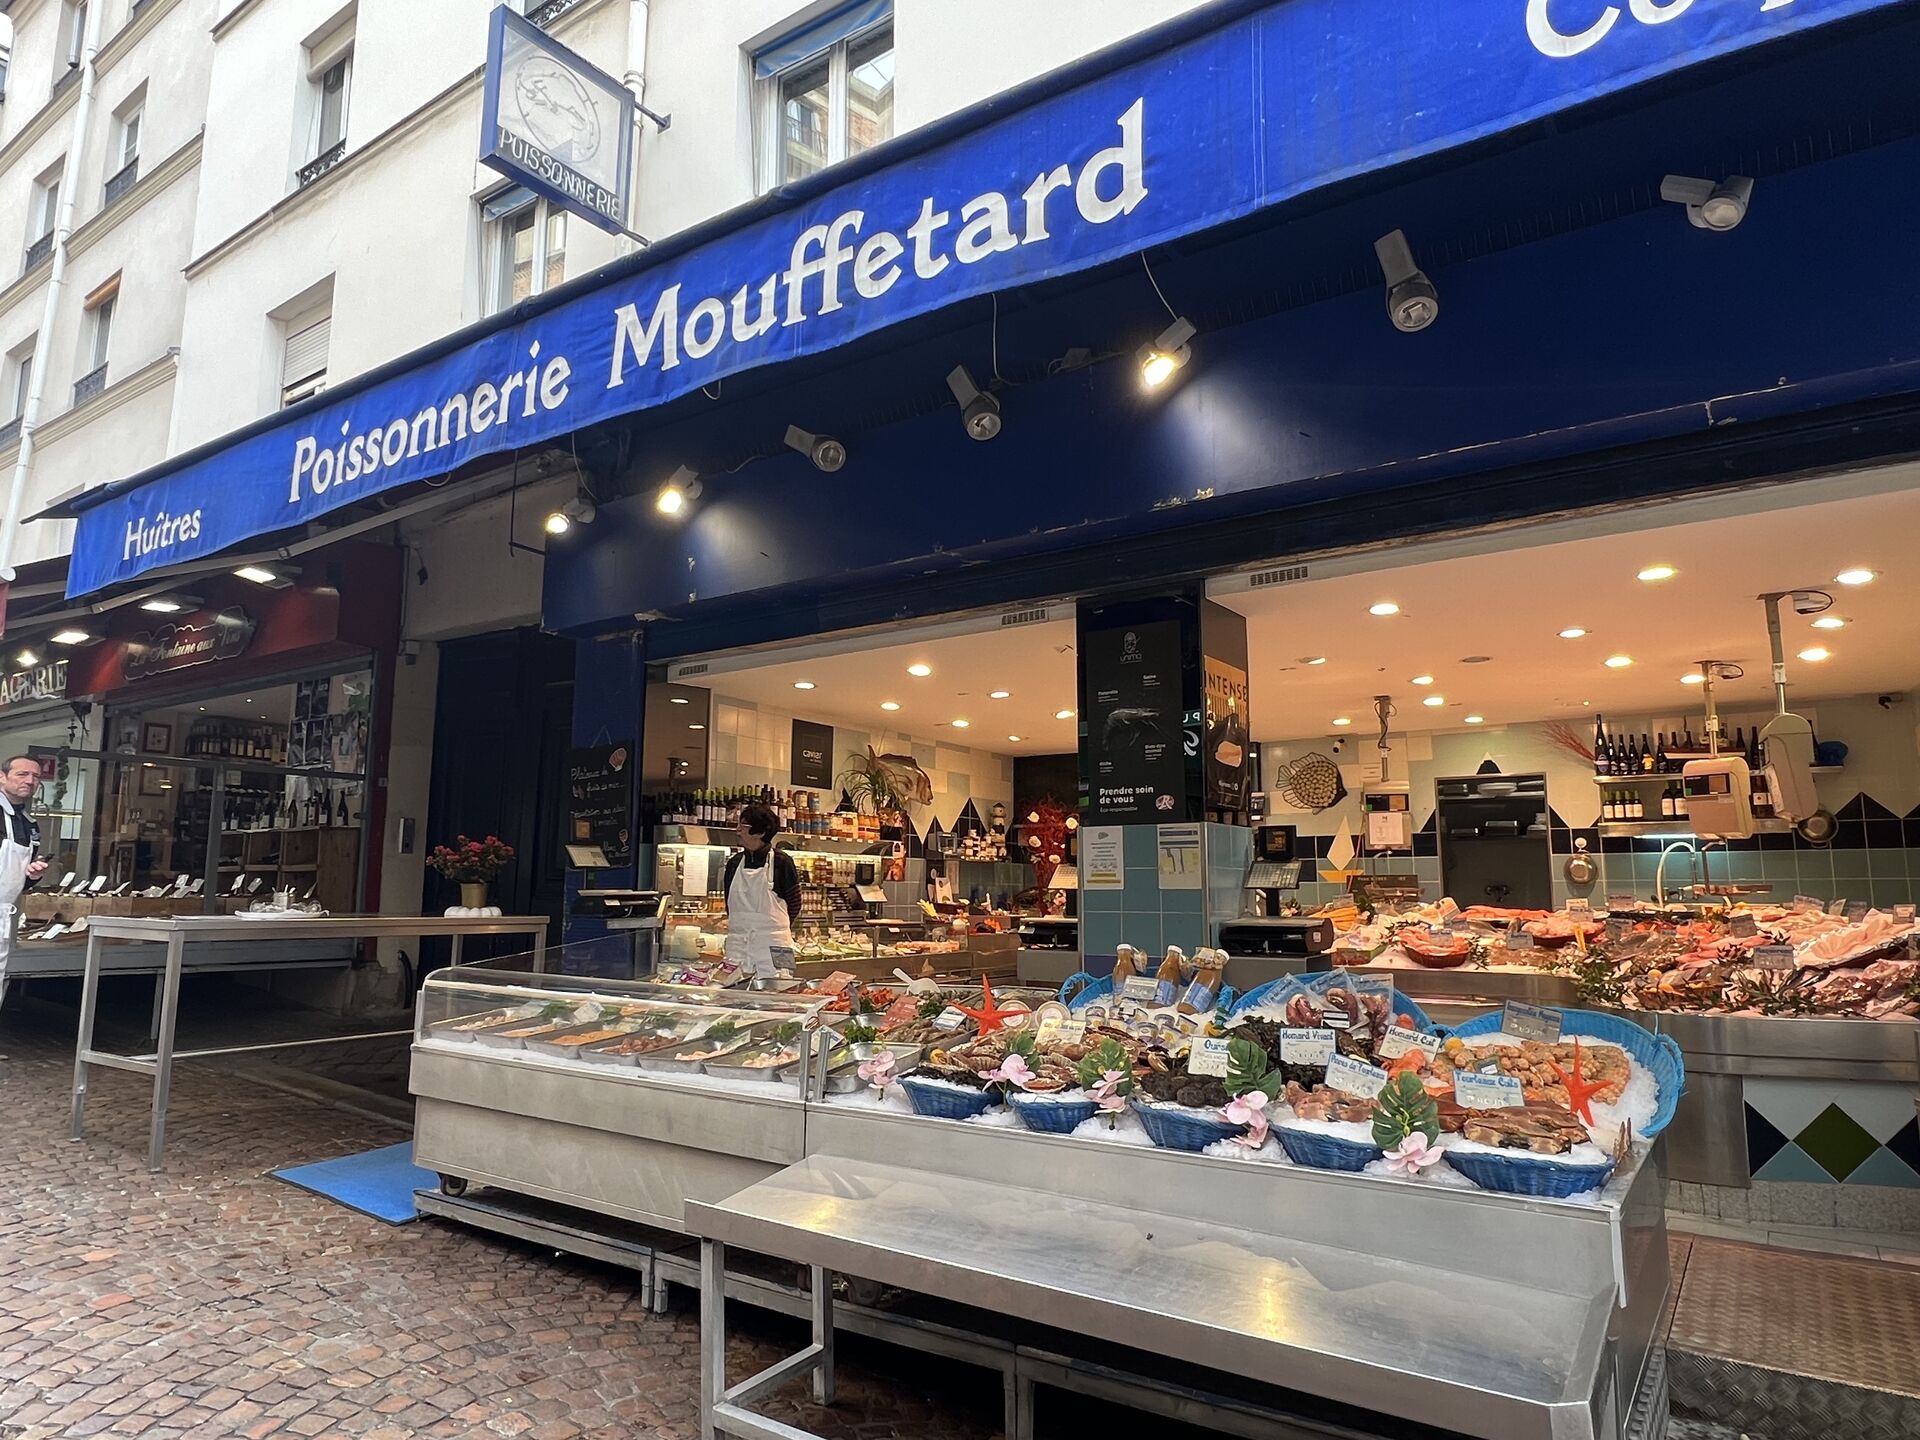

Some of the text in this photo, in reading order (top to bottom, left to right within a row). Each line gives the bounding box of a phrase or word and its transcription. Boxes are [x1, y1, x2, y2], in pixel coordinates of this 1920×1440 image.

[500, 127, 620, 220] POISSONNERIE
[288, 96, 1149, 503] Poissonnerie Mouffetard
[122, 509, 201, 561] Huîtres
[151, 637, 196, 661] Fontaine
[197, 638, 216, 652] aux
[0, 664, 67, 705] AGERIE
[1204, 671, 1247, 702] INTENSE
[1099, 796, 1134, 804] de vous
[1100, 785, 1154, 796] Prendre soin
[1204, 1039, 1229, 1051] Ours
[1282, 1029, 1333, 1040] Homard Vivant
[1388, 1027, 1436, 1047] Homard Cuit
